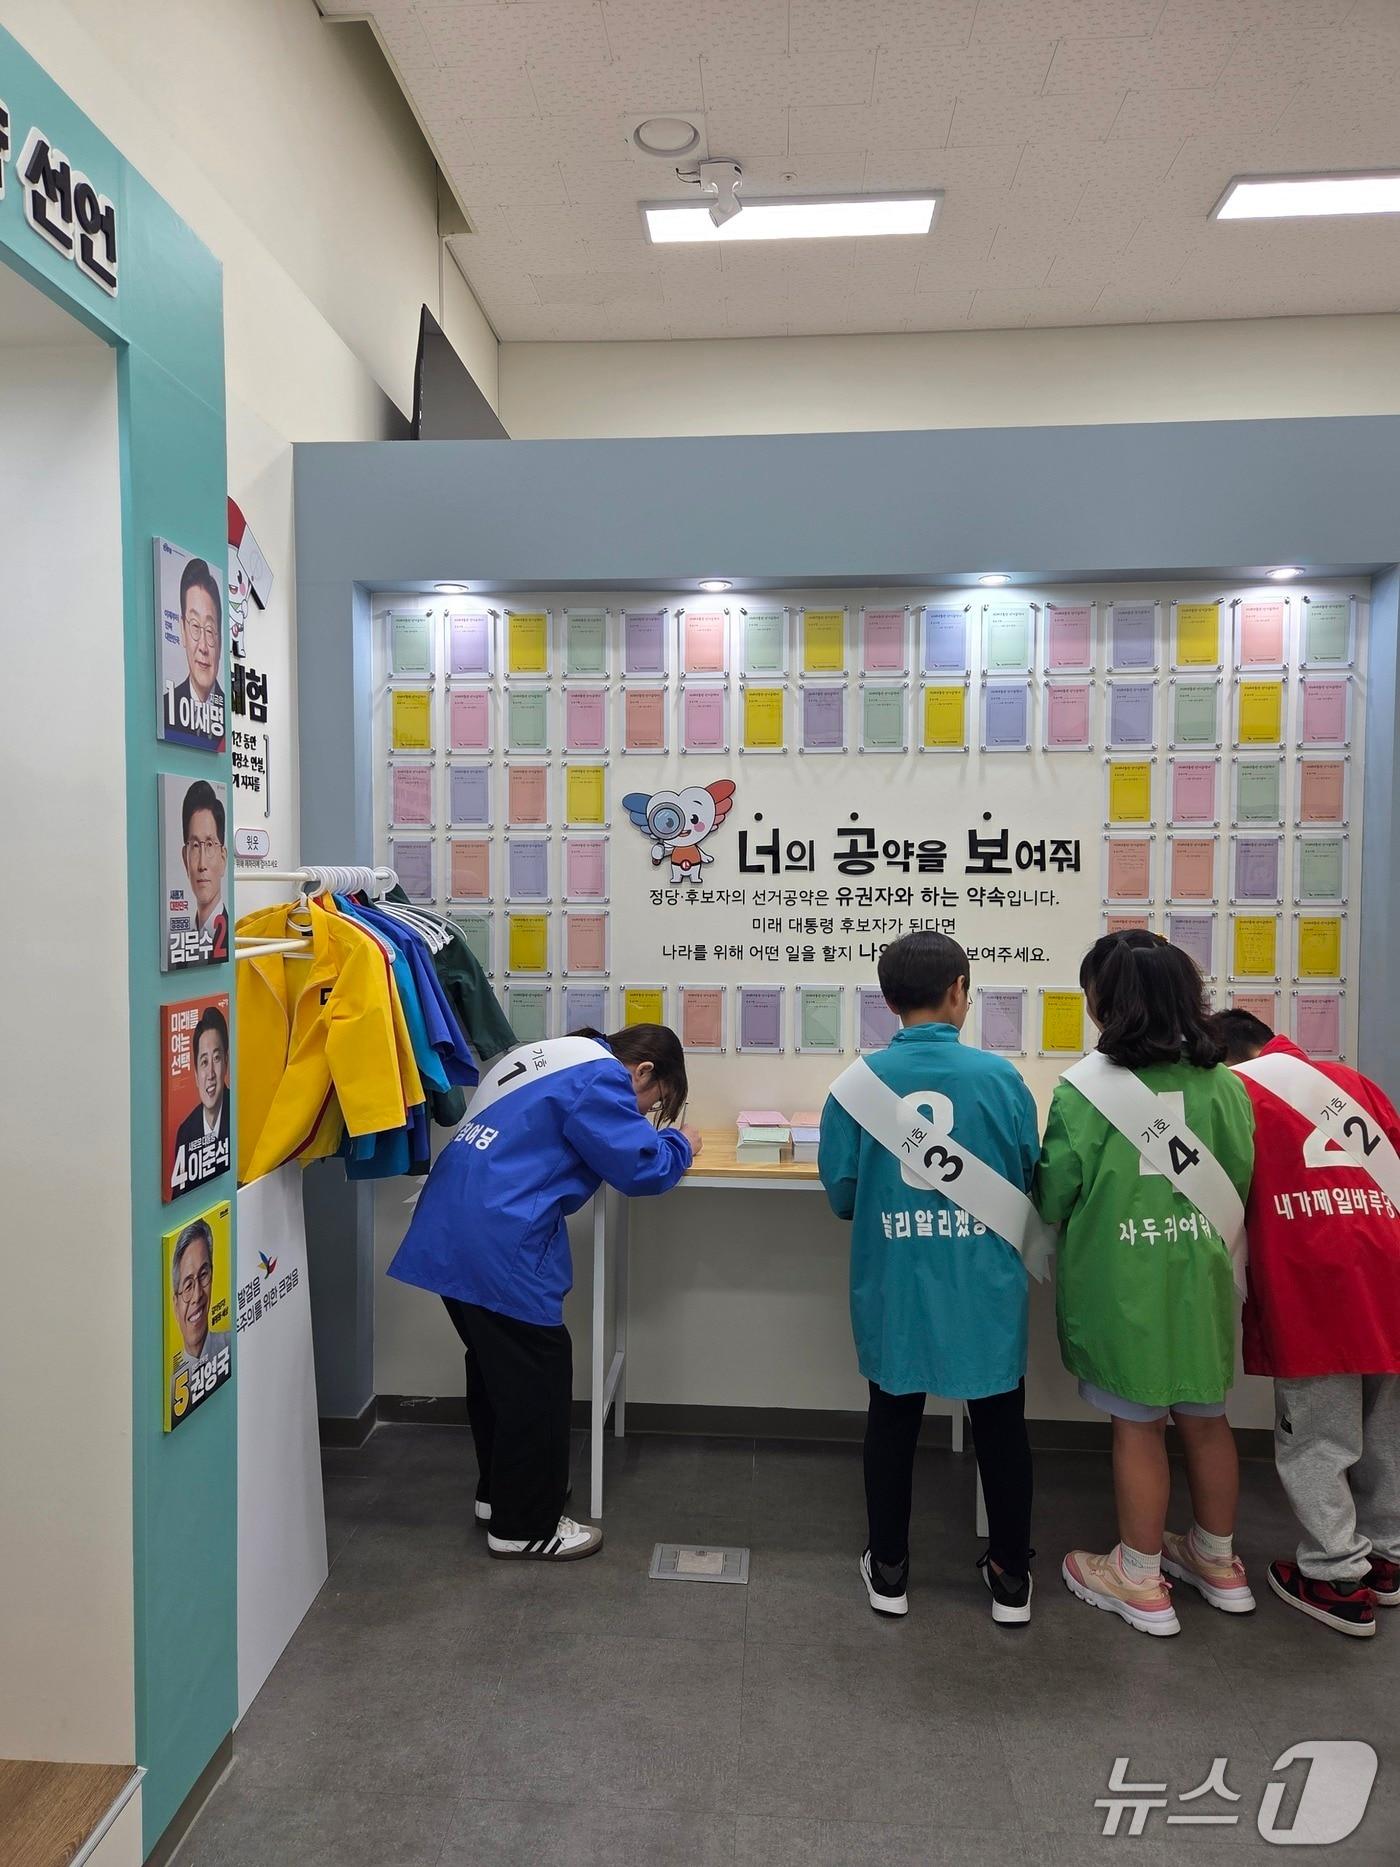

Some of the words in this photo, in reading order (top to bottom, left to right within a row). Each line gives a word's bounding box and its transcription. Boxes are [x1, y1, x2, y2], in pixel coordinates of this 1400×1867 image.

[25, 139, 117, 289] 선언
[166, 679, 175, 725] 1
[179, 697, 224, 737] 이재명
[232, 730, 242, 748] 간
[232, 751, 250, 769] 장소
[241, 775, 261, 793] 지지를
[738, 827, 815, 875] 너의
[833, 827, 948, 876] 공약을
[965, 828, 1081, 874] 보여줘
[649, 888, 746, 907] 정당·후보자의
[752, 889, 830, 907] 선거공약은
[835, 886, 914, 908] 유권자와
[920, 886, 960, 908] 하는
[966, 886, 1060, 908] 약속입니다.
[170, 931, 213, 963] 김문수
[213, 913, 228, 958] 2
[752, 917, 782, 934] 미래
[788, 917, 834, 935] 대통령
[840, 917, 903, 934] 후보자가
[908, 917, 956, 935] 된다면
[662, 944, 707, 962] 나라를
[713, 944, 744, 961] 위해
[749, 945, 779, 961] 어떤
[785, 945, 816, 962] 일을
[822, 945, 853, 962] 할지
[967, 947, 1050, 963] 보여주세요.
[171, 1008, 199, 1033] 미래를
[171, 1033, 190, 1053] 여는
[171, 1051, 191, 1076] 선택
[497, 1060, 527, 1087] 1
[532, 1048, 548, 1071] 기호
[1320, 1097, 1347, 1121] 기호
[1343, 1115, 1381, 1156] 2
[171, 1144, 188, 1191] 4
[188, 1137, 229, 1182] 이준석
[902, 1127, 928, 1153] 기호
[923, 1145, 964, 1183] 3
[1141, 1118, 1171, 1143] 기호
[1168, 1135, 1201, 1175] 4
[237, 1276, 261, 1311] 발걸음
[263, 1286, 278, 1312] 위한
[173, 1370, 190, 1418] 5
[190, 1345, 230, 1405] 권영국
